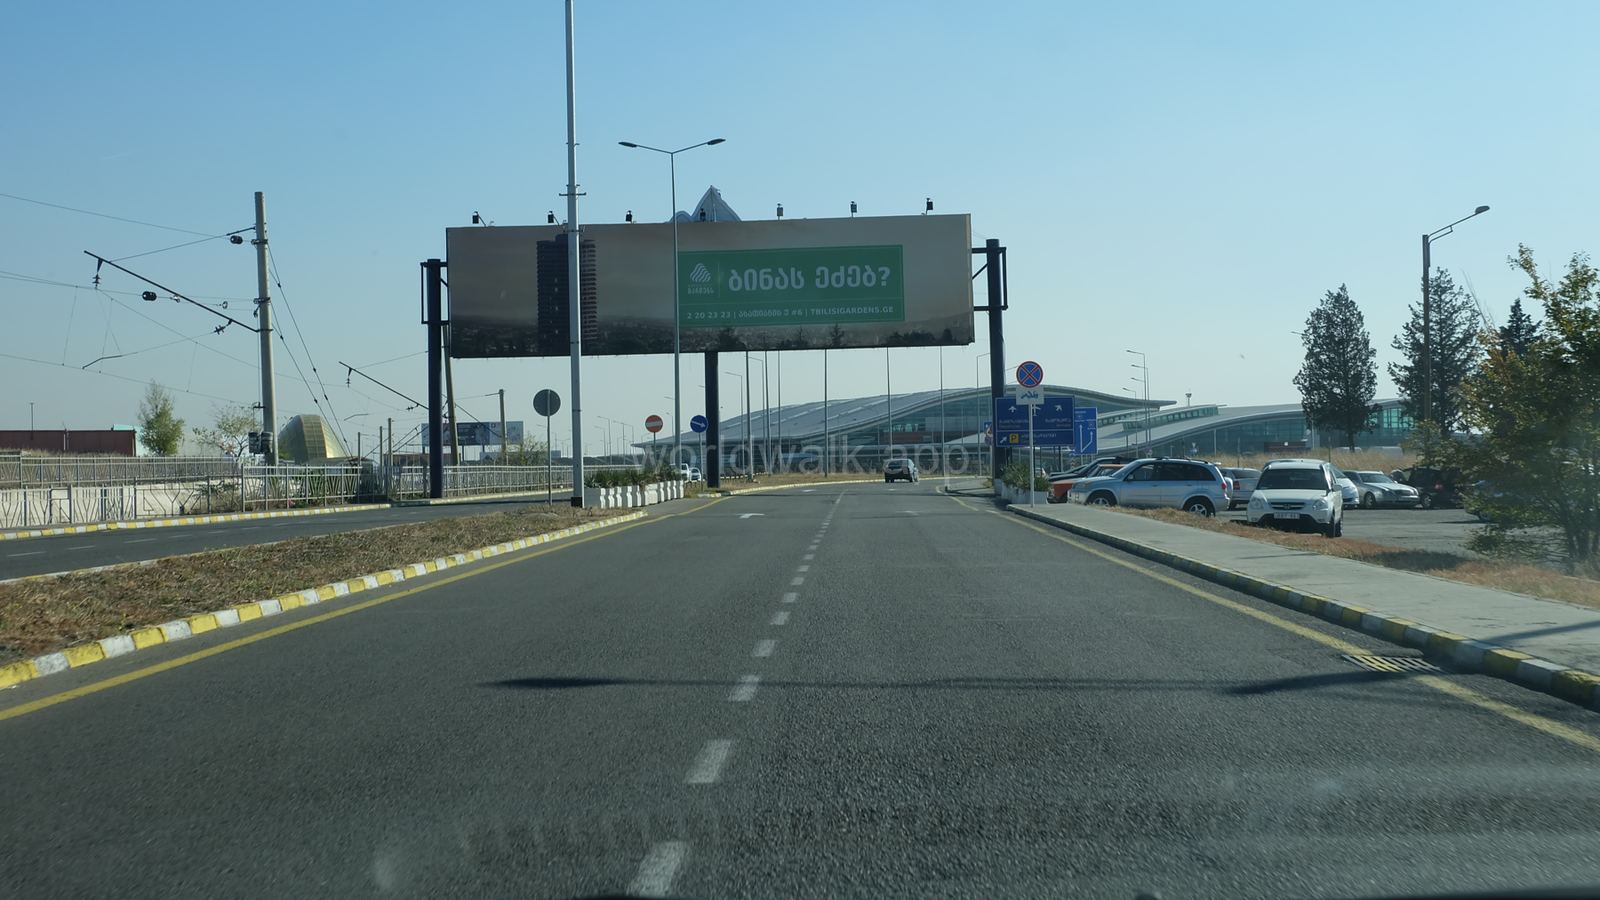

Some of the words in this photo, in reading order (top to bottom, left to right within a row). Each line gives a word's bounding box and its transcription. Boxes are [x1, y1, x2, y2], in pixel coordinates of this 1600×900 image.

[728, 267, 805, 292] ბინას
[815, 264, 891, 289] ეძებ?
[694, 311, 705, 319] 20
[707, 311, 718, 319] 23
[810, 306, 894, 316] TBILISIGARDENS.GE
